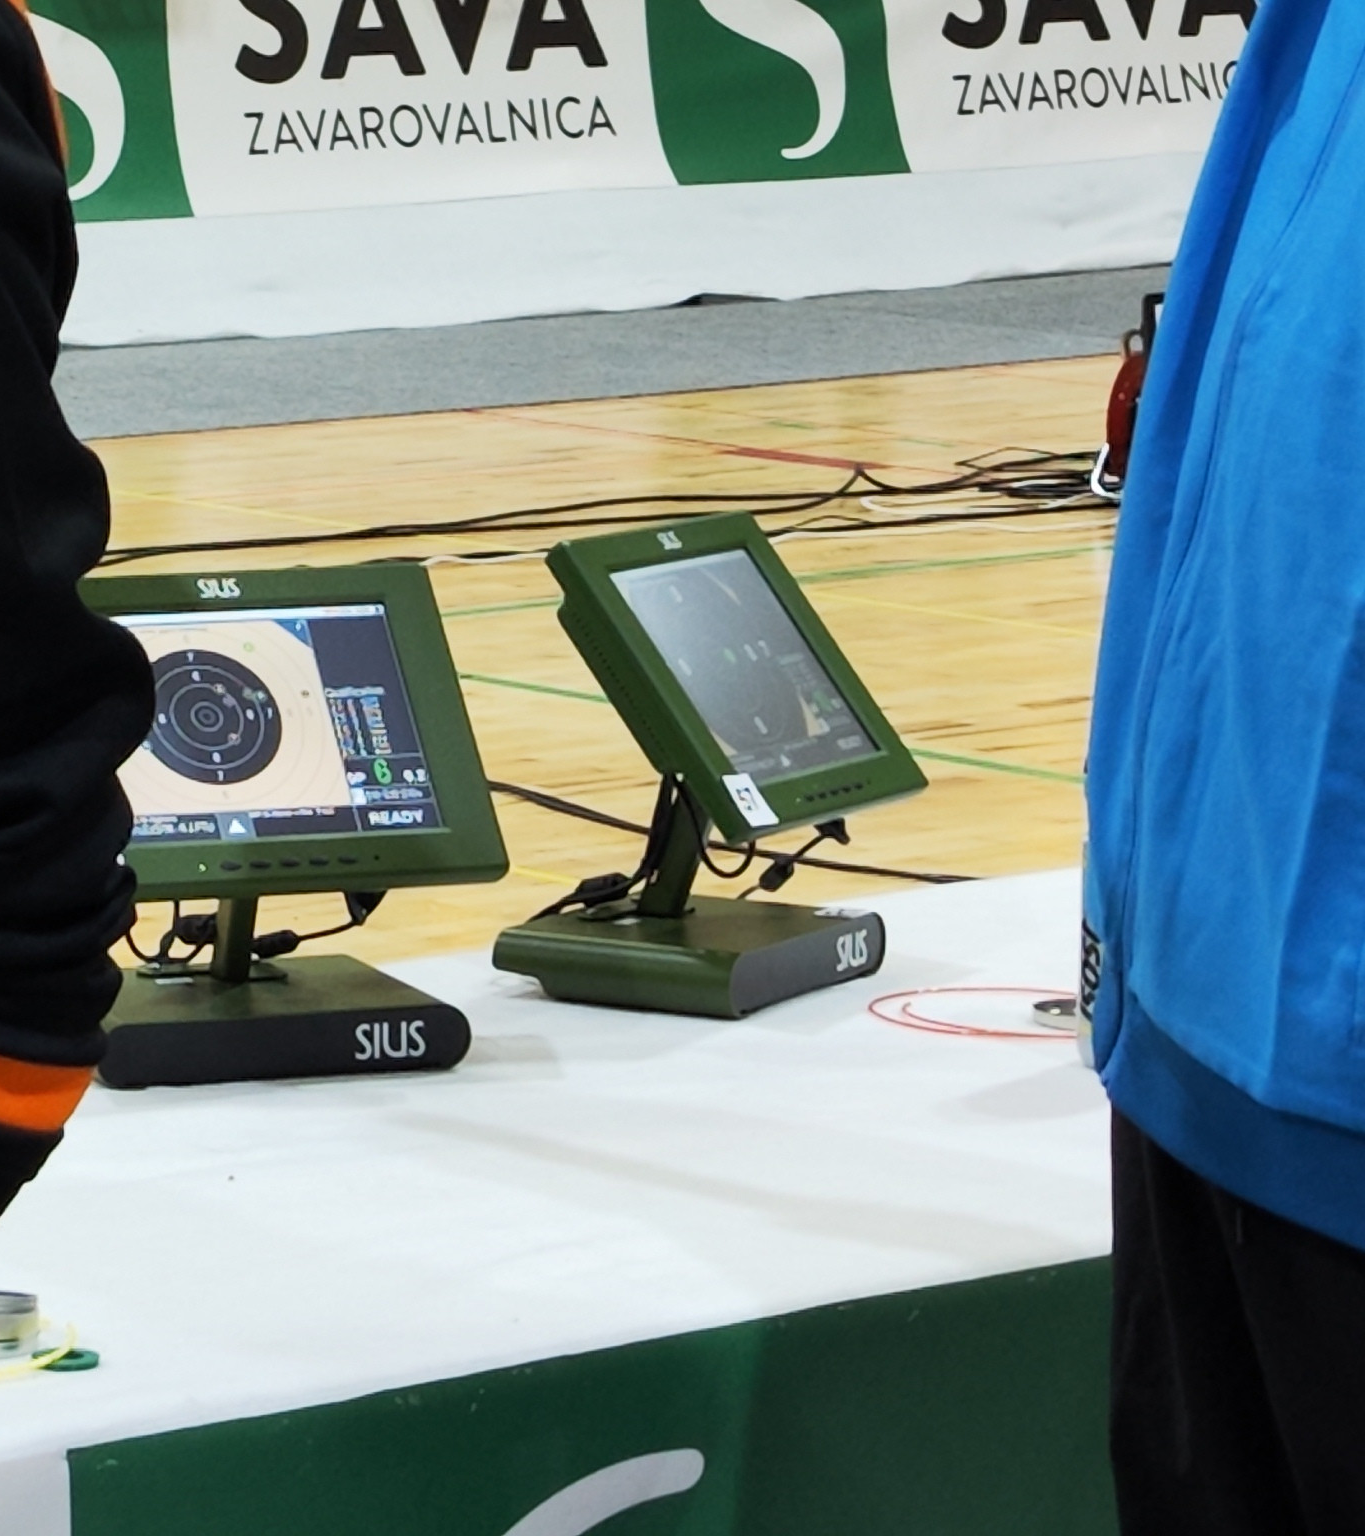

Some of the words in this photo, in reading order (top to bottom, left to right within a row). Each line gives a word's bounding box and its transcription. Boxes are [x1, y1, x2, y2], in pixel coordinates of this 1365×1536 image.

[243, 96, 617, 155] ZAVAROVALNICA
[835, 928, 868, 972] SIUS
[354, 1020, 427, 1061] SIUS
